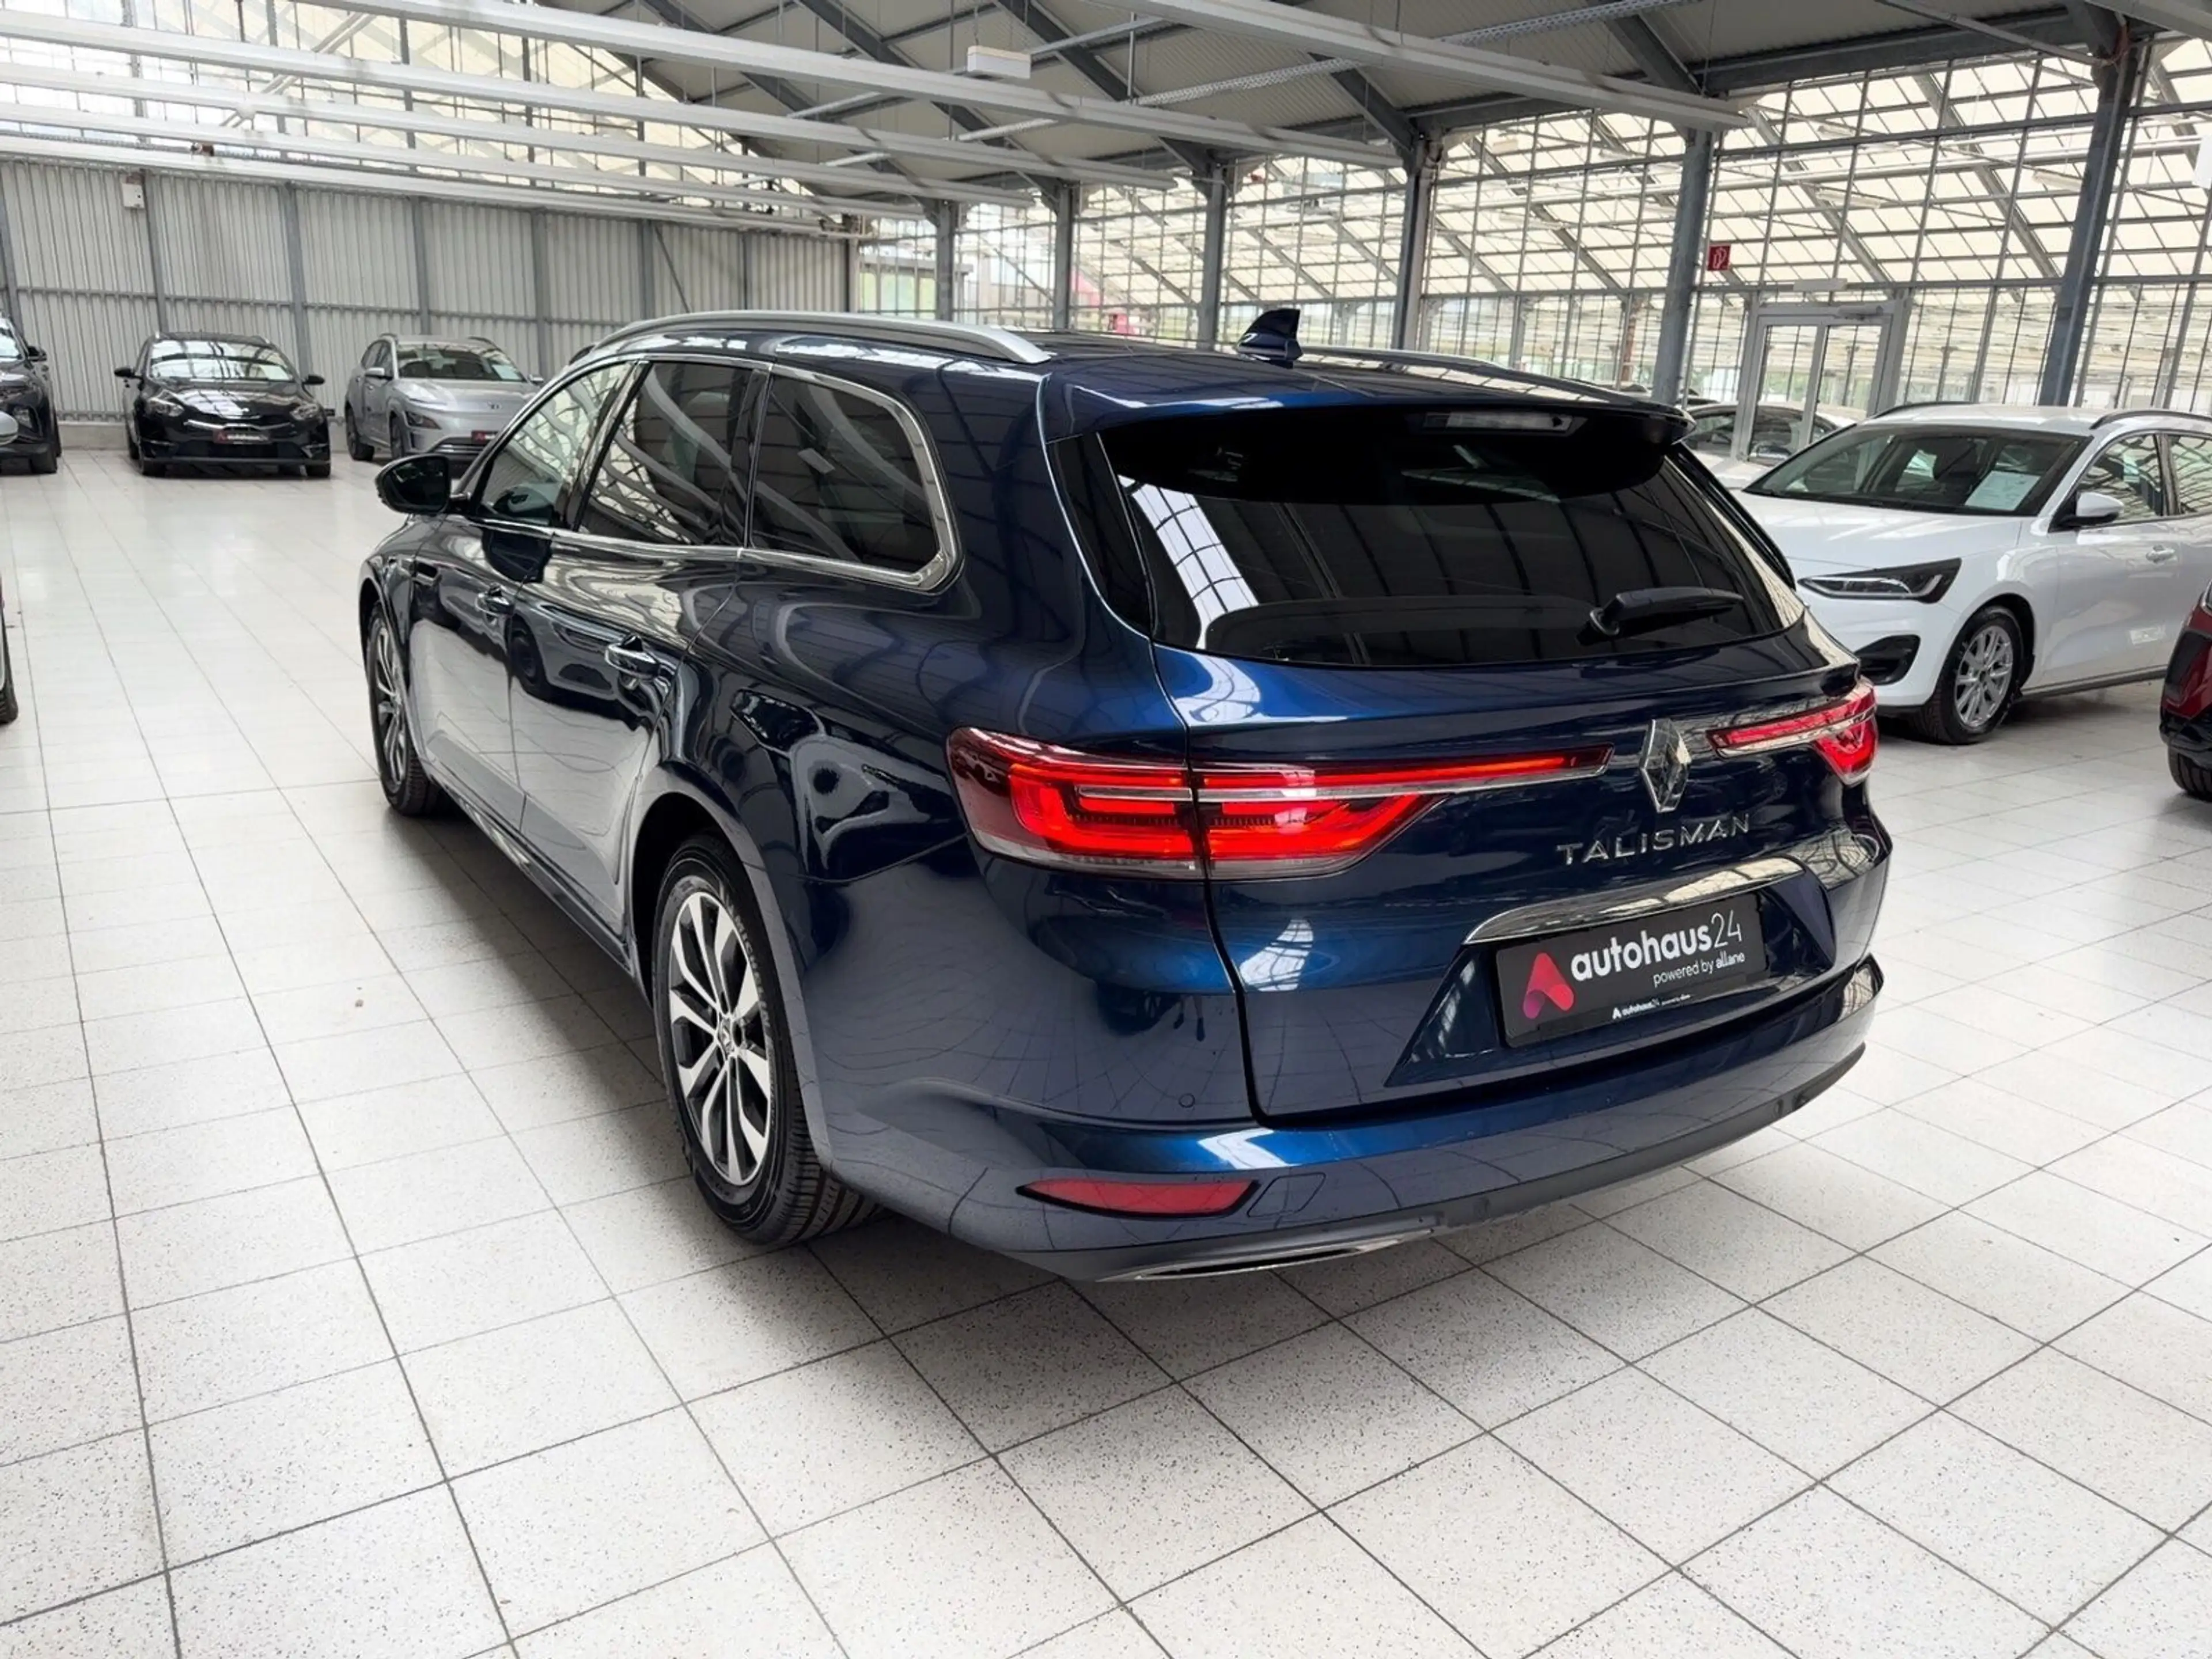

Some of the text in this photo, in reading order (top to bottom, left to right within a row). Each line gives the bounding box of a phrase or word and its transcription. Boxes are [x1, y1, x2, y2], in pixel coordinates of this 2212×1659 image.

[1556, 813, 1749, 865] TALISMAN
[1570, 910, 1743, 982] autohaus24
[1653, 950, 1745, 988] powered by allane
